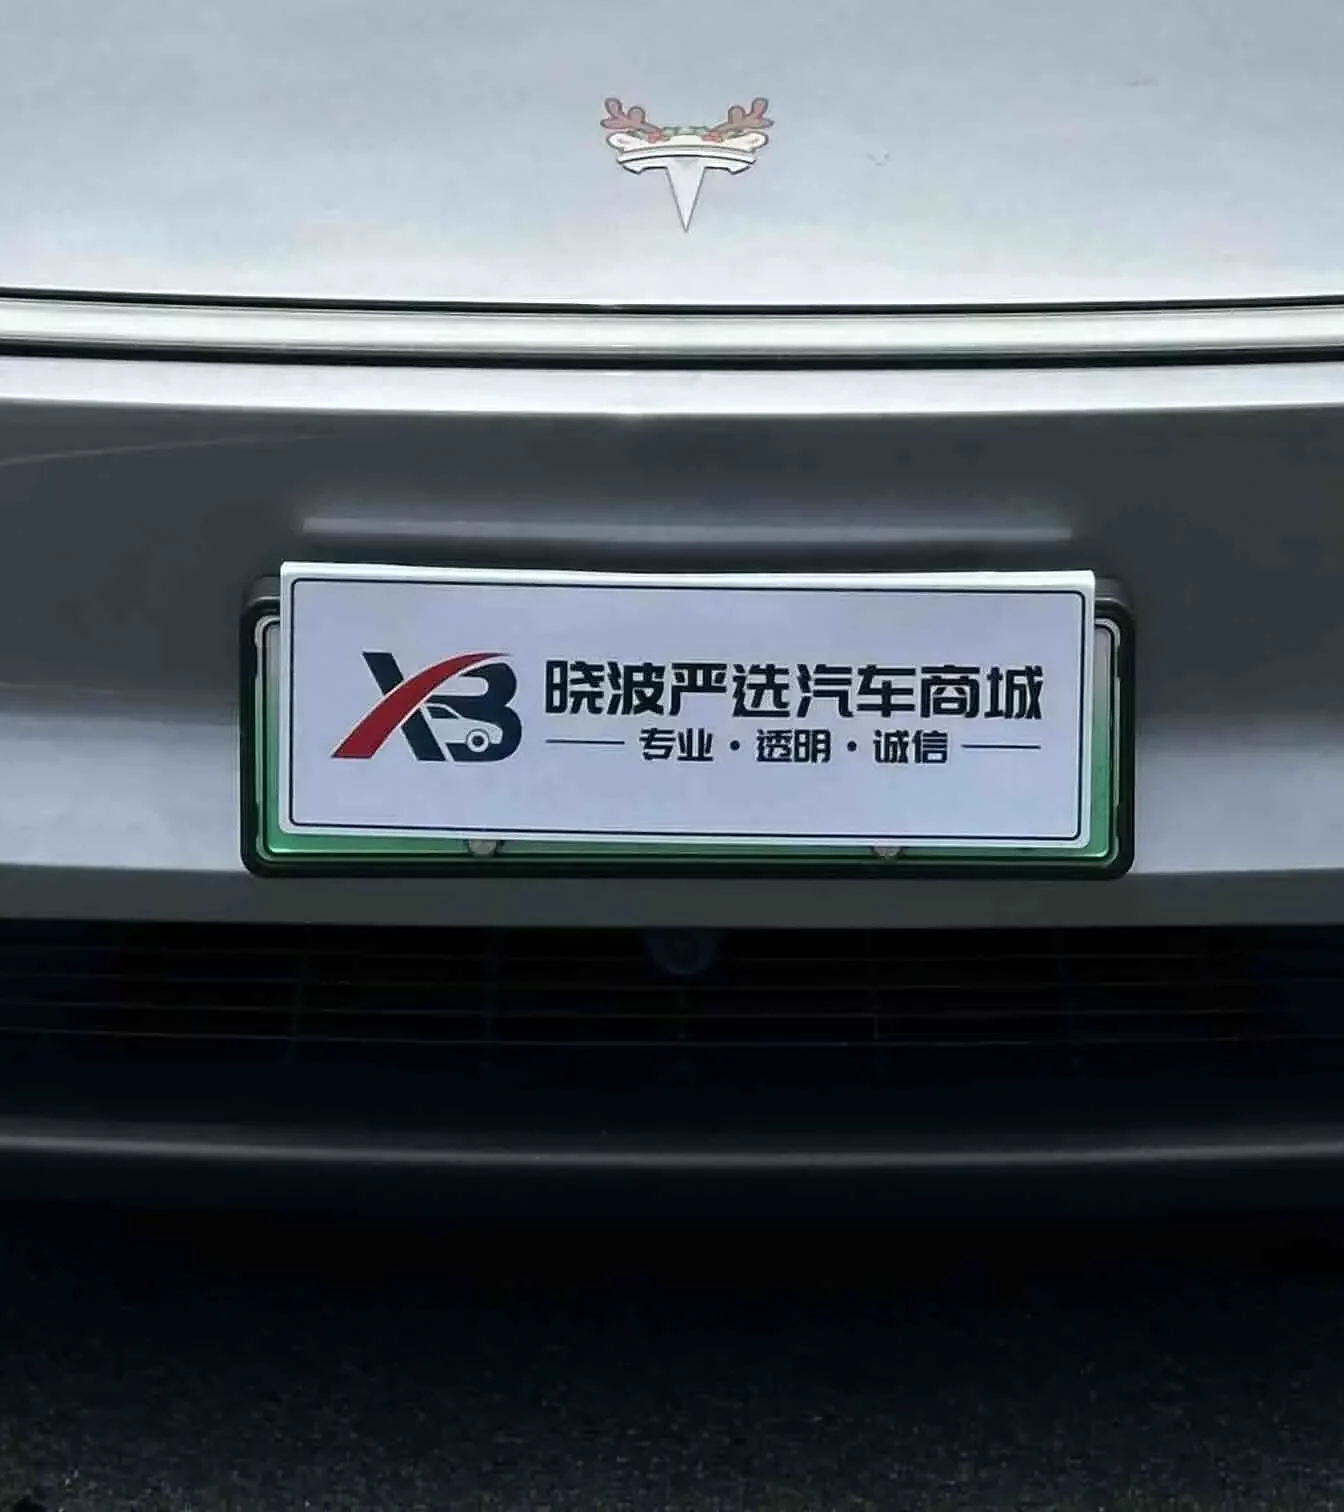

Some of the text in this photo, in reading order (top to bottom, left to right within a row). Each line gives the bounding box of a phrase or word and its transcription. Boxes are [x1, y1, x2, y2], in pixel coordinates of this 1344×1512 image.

[544, 659, 1044, 721] 晓波严选汽车商城
